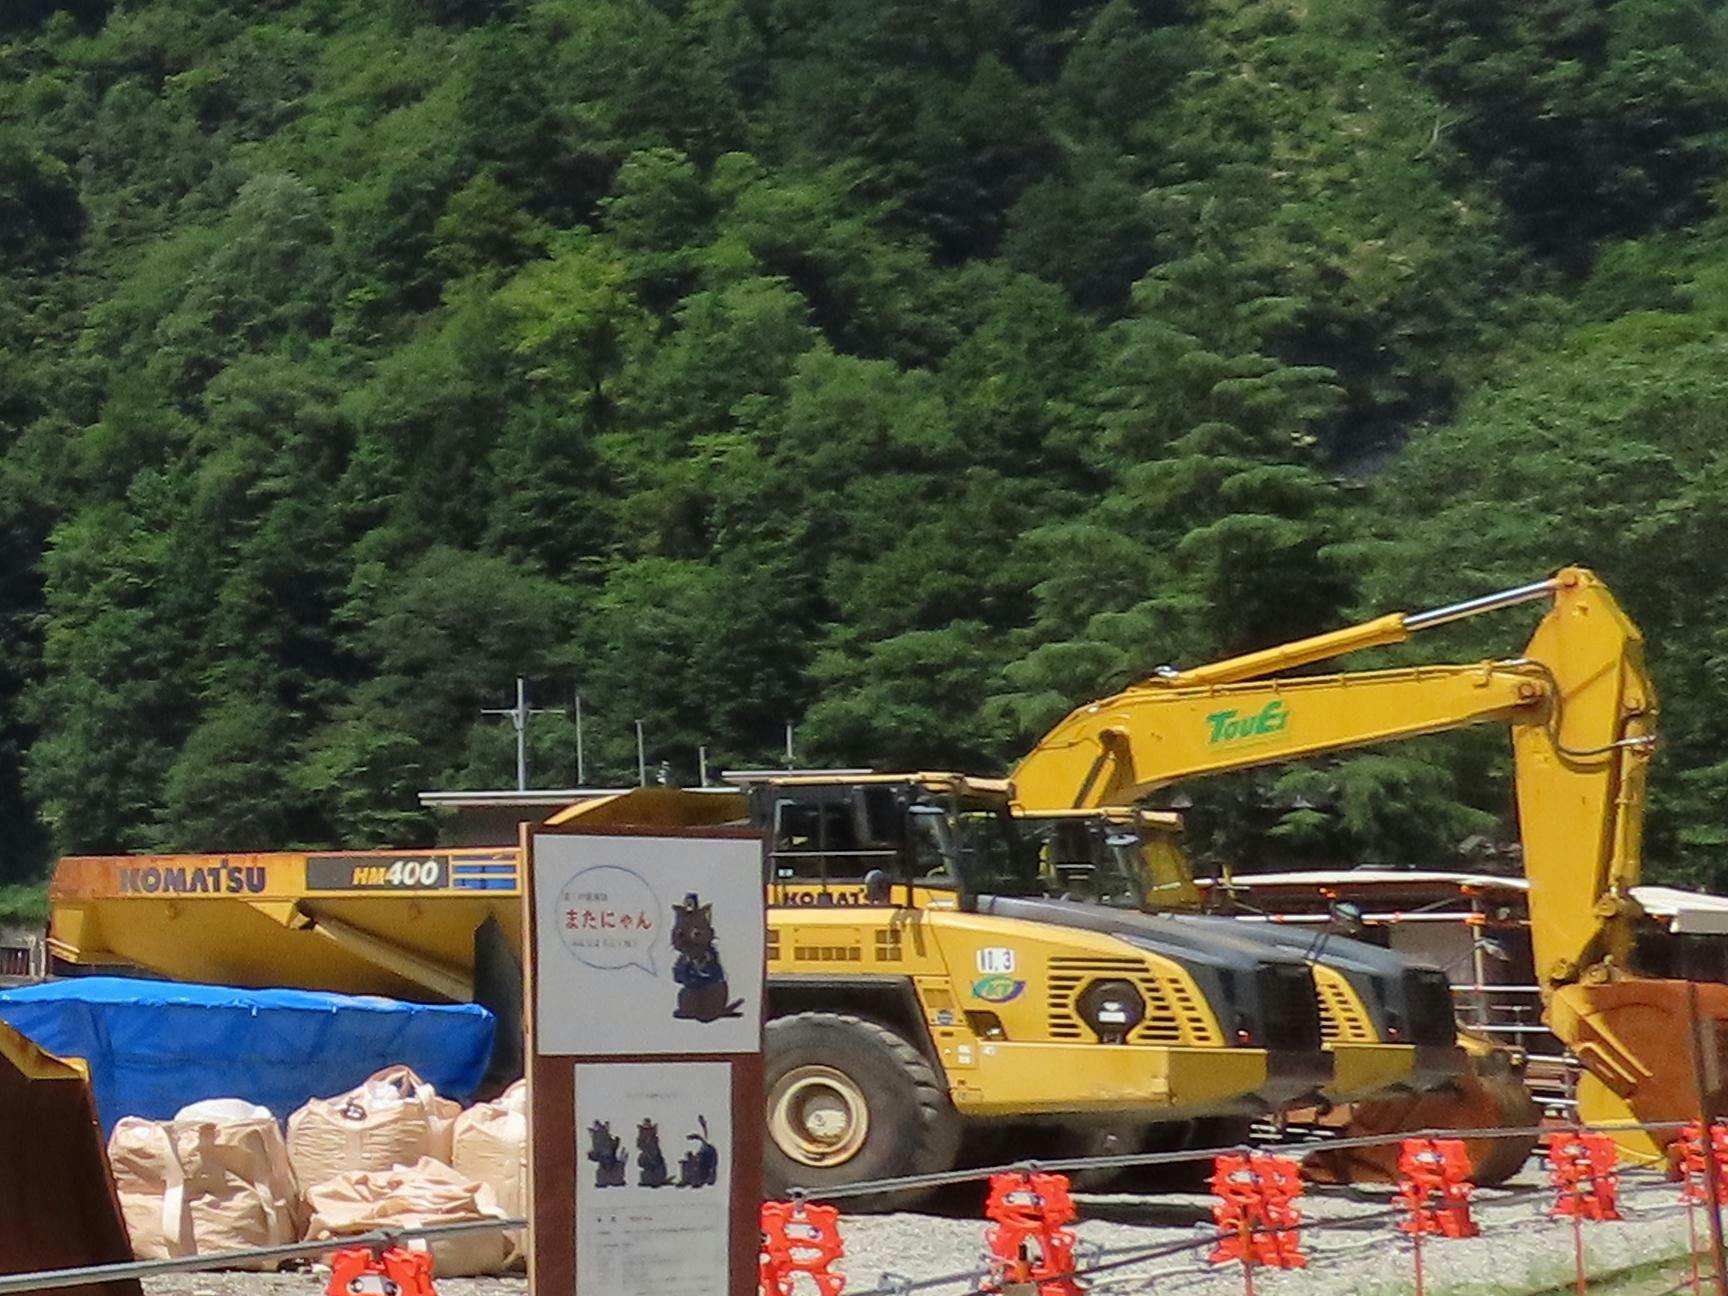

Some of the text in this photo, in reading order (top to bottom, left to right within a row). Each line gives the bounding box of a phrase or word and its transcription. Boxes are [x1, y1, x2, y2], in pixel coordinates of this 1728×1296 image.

[120, 858, 266, 894] KOMATSU
[352, 860, 439, 886] HM400
[565, 908, 652, 930] またにゃん
